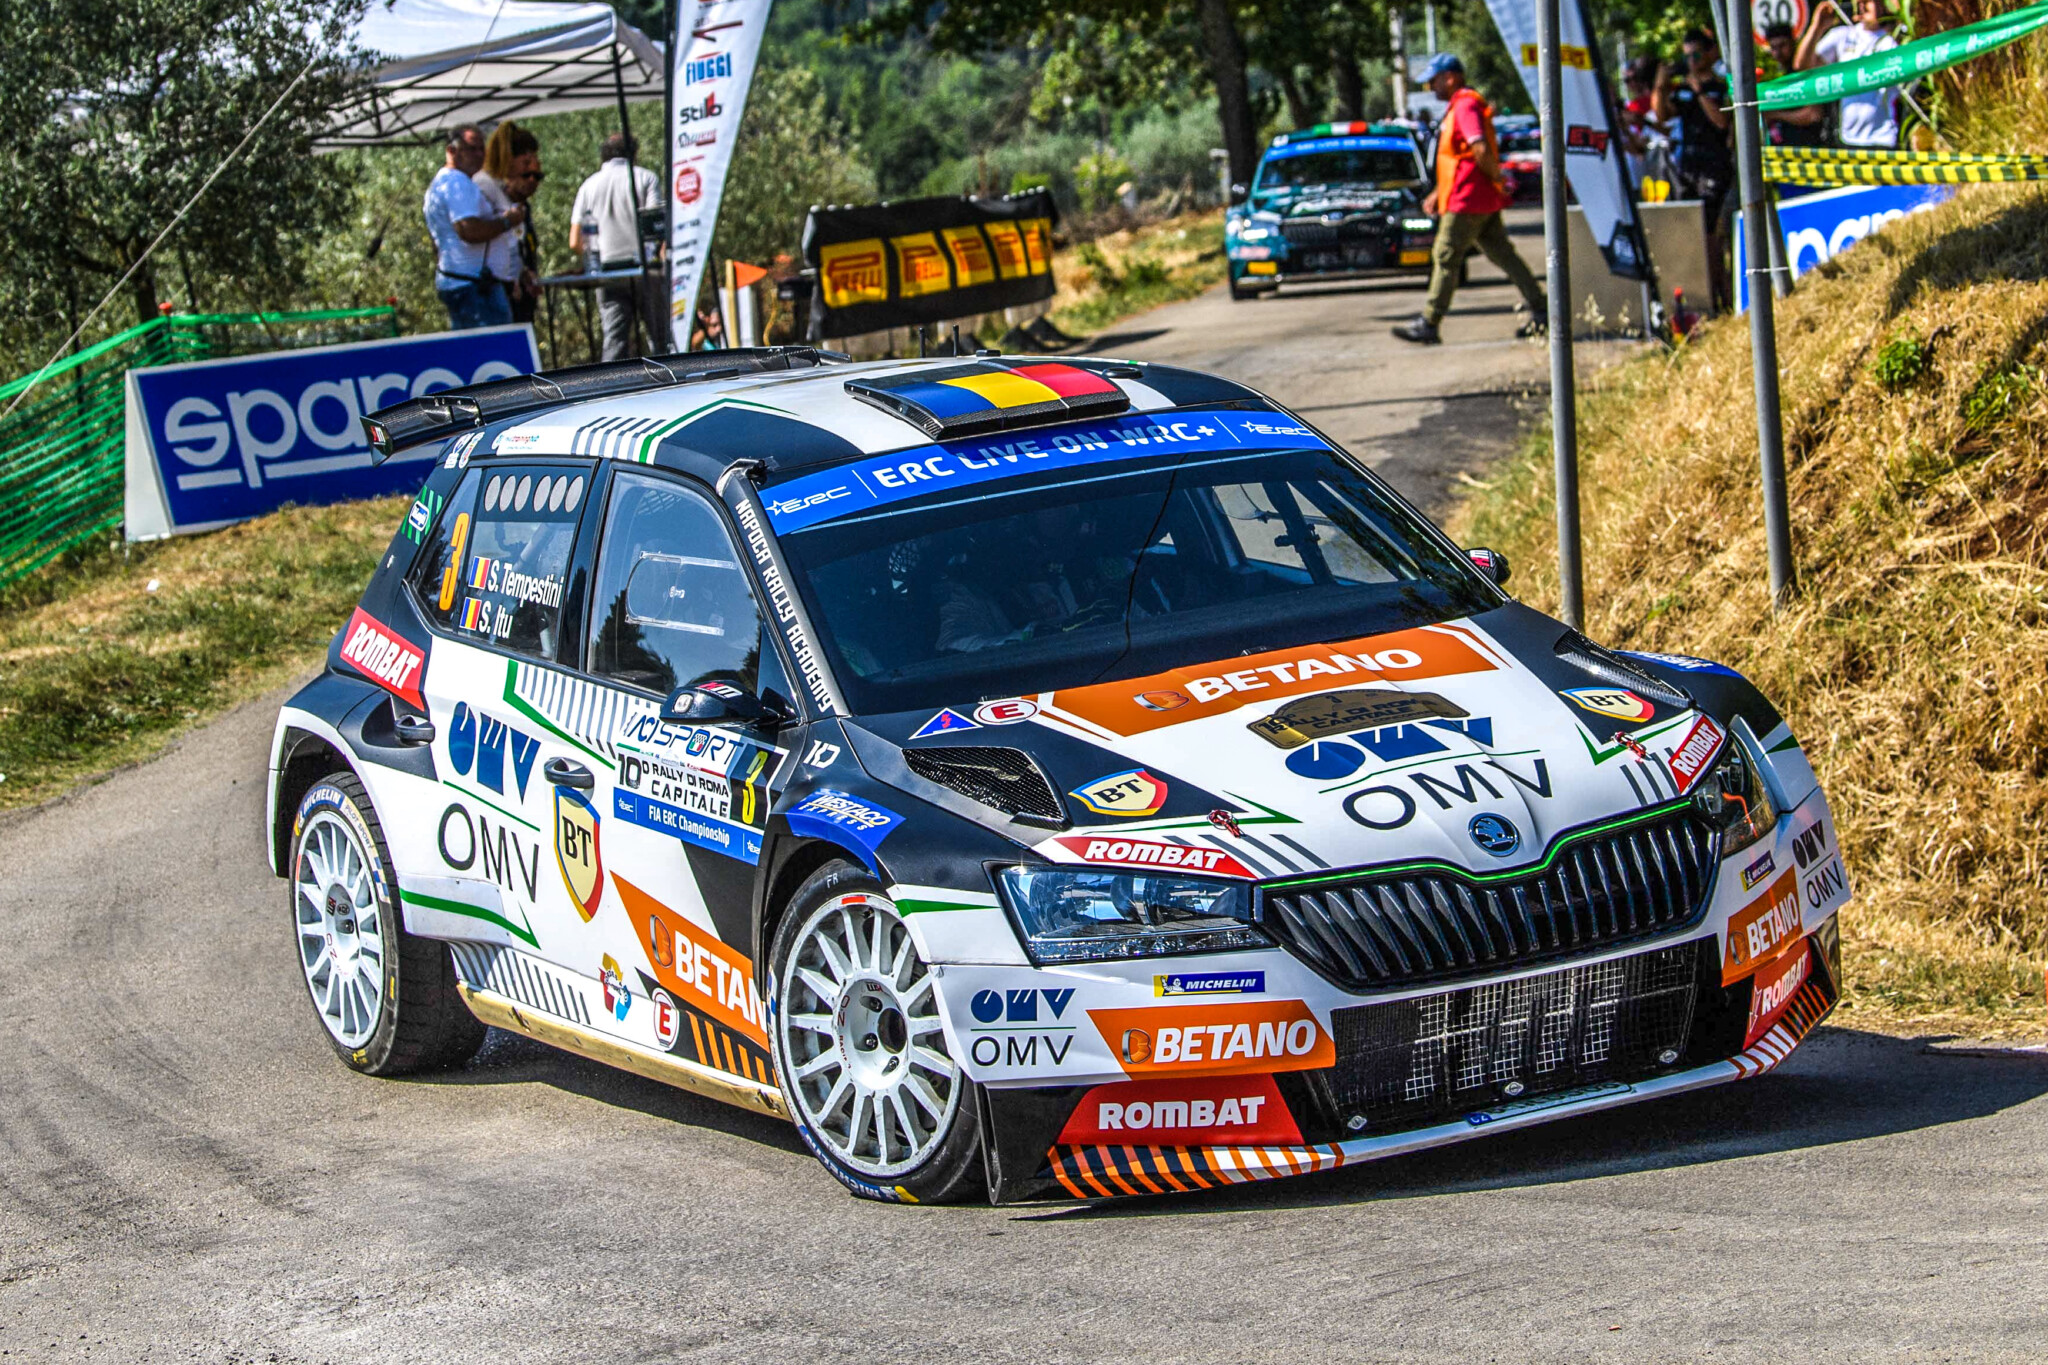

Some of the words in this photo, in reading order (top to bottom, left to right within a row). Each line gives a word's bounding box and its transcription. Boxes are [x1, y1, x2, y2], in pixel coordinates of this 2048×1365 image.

[1759, 0, 1792, 28] 30
[686, 52, 732, 86] FIUGGI
[873, 456, 954, 488] ERC
[958, 439, 1048, 472] LIVE
[1053, 430, 1109, 456] ON
[1116, 422, 1217, 447] WRC+
[438, 512, 470, 611] 3
[487, 559, 500, 593] S.
[501, 562, 564, 609] Tempestini
[478, 600, 491, 632] S.
[493, 605, 514, 639] Itu
[735, 500, 772, 565] NAPOCA
[763, 564, 796, 623] RALLY
[786, 623, 834, 714] ACADEMY
[343, 622, 421, 689] ROMBAT
[1184, 648, 1423, 704] BETANO
[991, 703, 1025, 720] E
[1583, 694, 1627, 706] BT
[1672, 724, 1720, 777] ROMBAT
[304, 788, 342, 816] MICHELIN
[651, 780, 729, 818] CAPITALE
[652, 763, 683, 783] RALLY
[687, 773, 697, 787] DI
[699, 777, 729, 798] ROMA
[742, 751, 769, 825] 3
[1093, 778, 1142, 804] BT
[1342, 758, 1553, 831] OMV
[562, 815, 592, 868] BT
[648, 804, 661, 822] FIA
[663, 811, 678, 828] ERC
[679, 814, 730, 849] Championship
[438, 803, 540, 903] OMV
[1084, 840, 1226, 870] ROMBAT
[1806, 861, 1843, 909] OMV
[1746, 892, 1800, 959] BETANO
[1186, 978, 1257, 990] MICHELIN
[1761, 950, 1809, 1017] ROMBAT
[659, 1001, 671, 1036] E
[1153, 1018, 1317, 1064] BETANO
[971, 1035, 1074, 1066] OMV
[1098, 1096, 1266, 1130] ROMBAT
